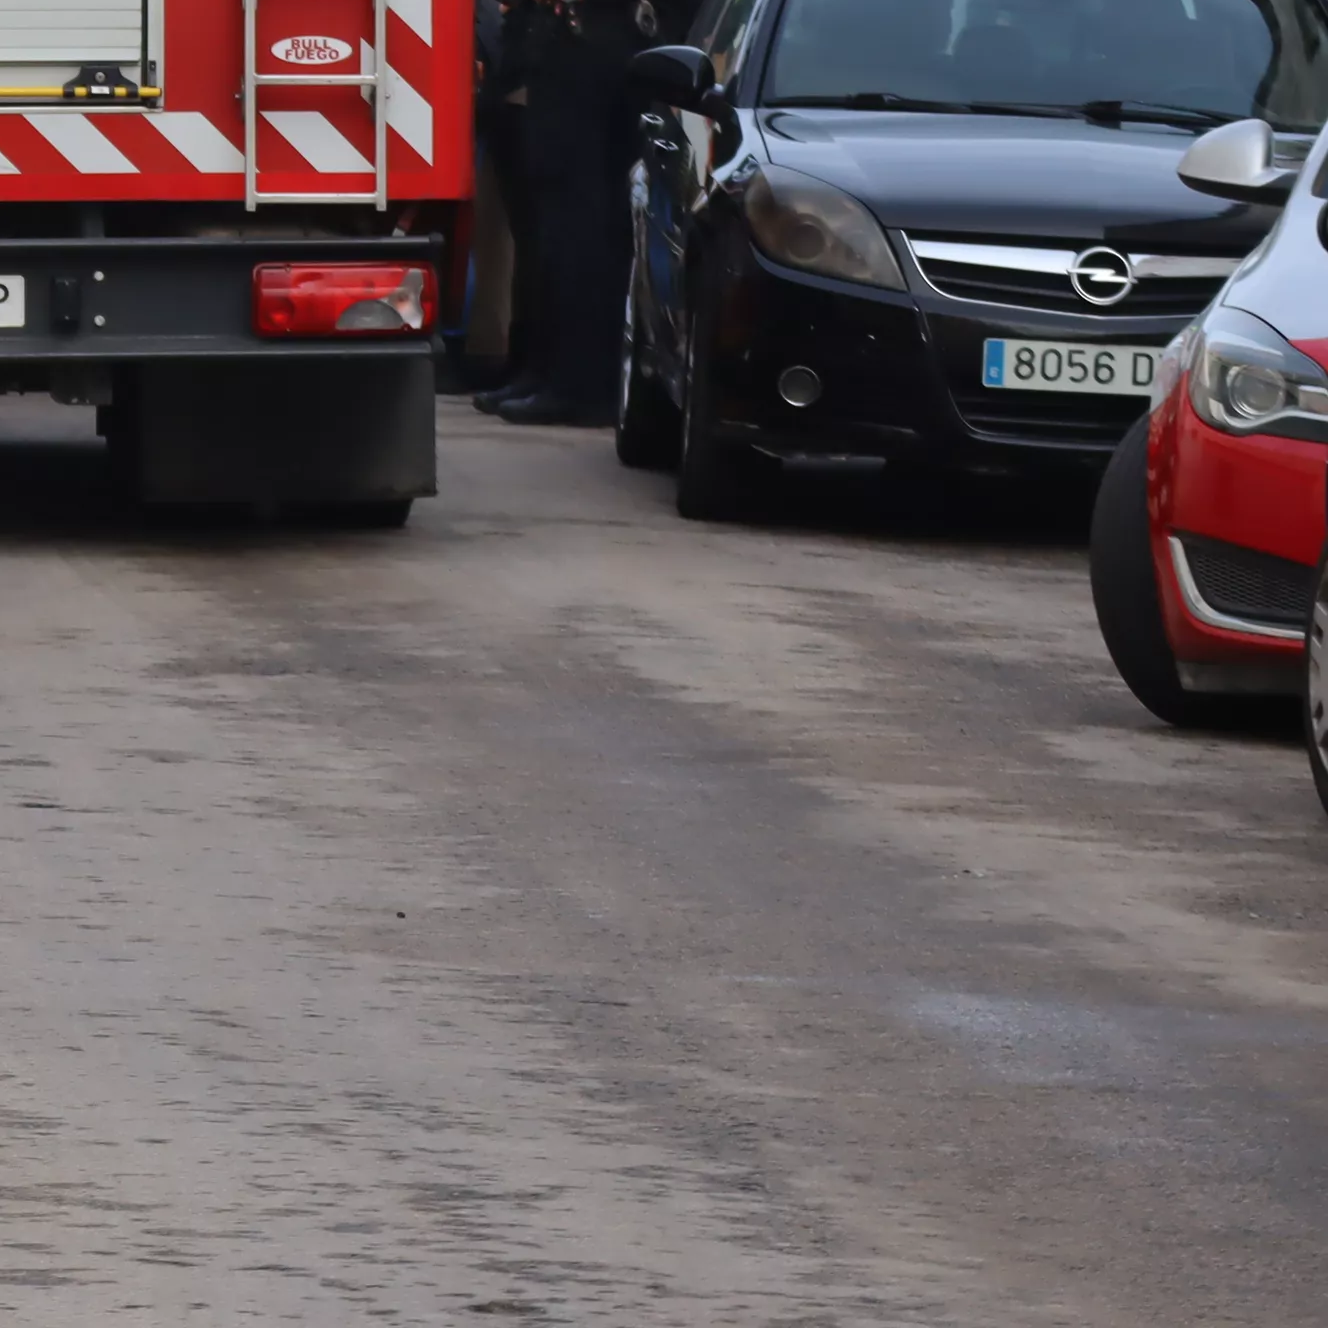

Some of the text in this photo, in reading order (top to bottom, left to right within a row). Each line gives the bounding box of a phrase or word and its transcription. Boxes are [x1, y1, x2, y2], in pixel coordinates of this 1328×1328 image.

[291, 39, 332, 50] BULL
[285, 49, 340, 60] FUEGO
[1013, 347, 1116, 384] 8056
